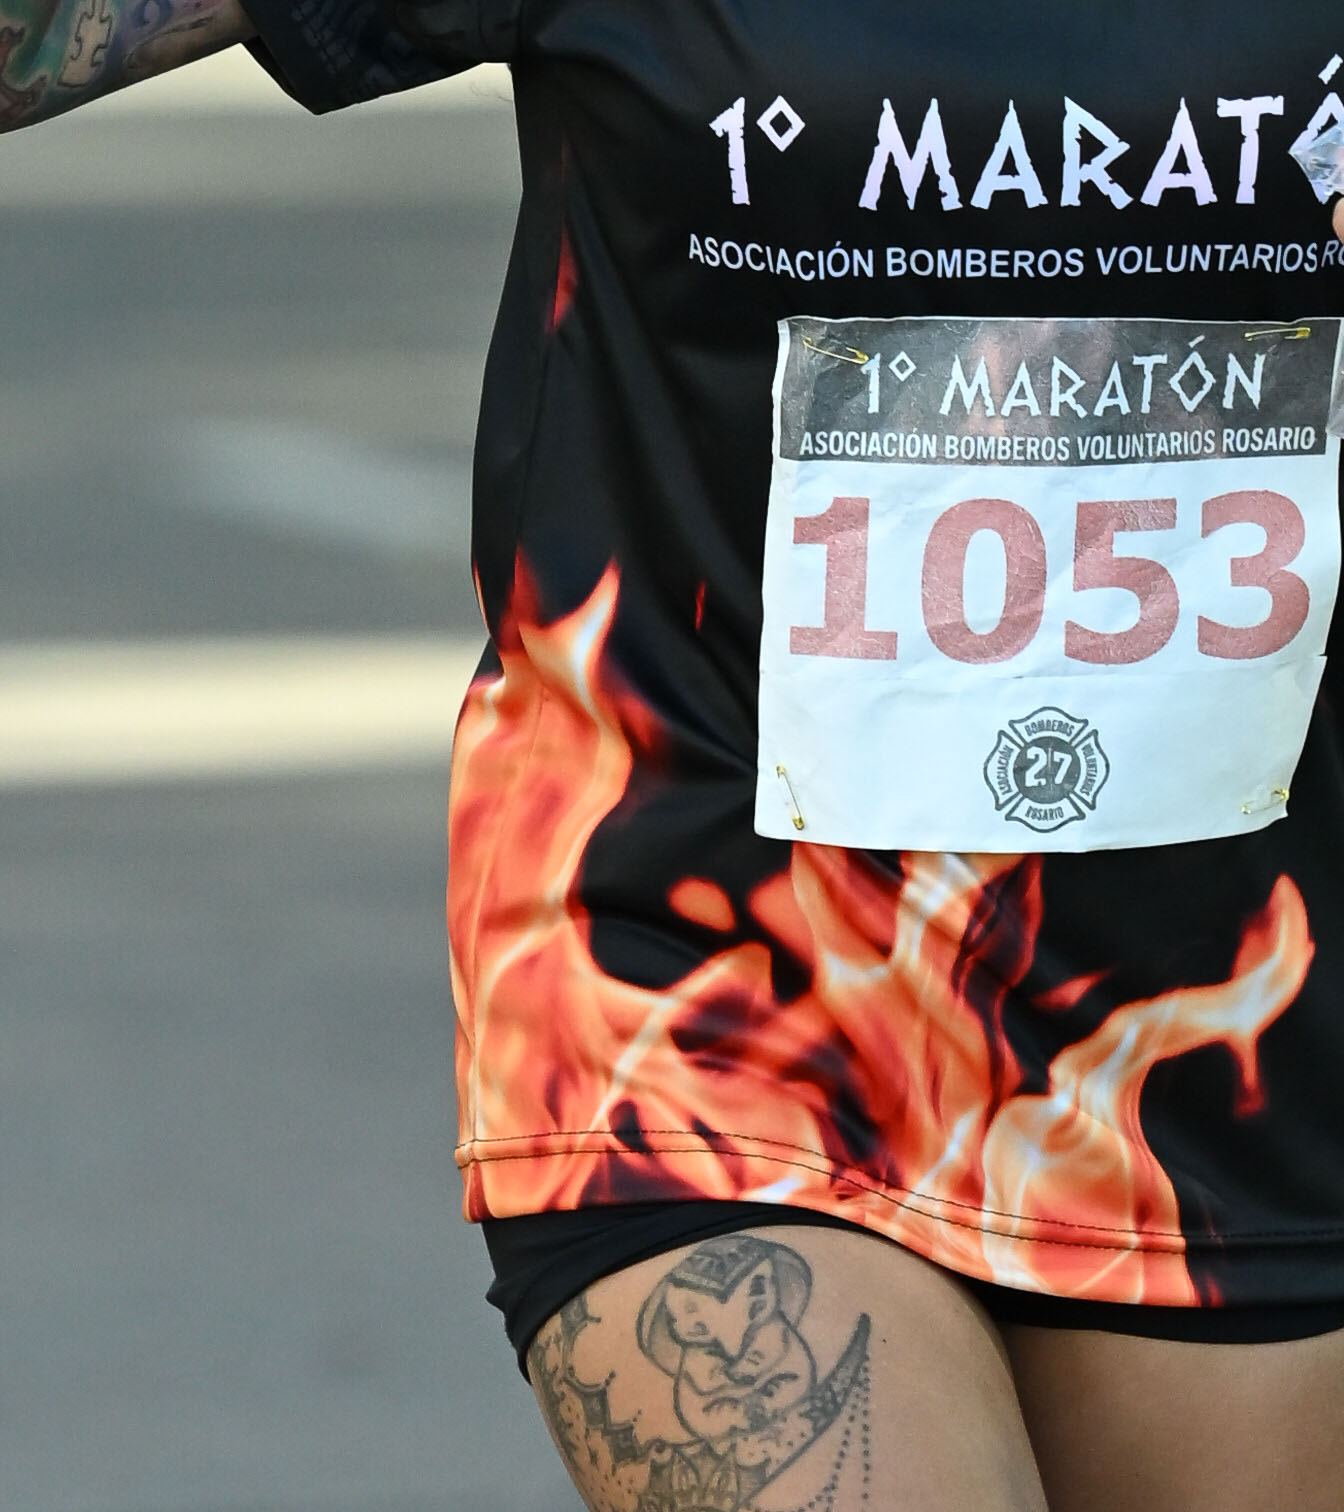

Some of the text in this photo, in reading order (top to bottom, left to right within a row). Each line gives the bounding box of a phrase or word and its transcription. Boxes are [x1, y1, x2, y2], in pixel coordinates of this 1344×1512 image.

[688, 233, 874, 281] ASOCIACIÓN
[886, 246, 1085, 278] BOMBEROS
[1096, 242, 1317, 274] VOLUNTARIOS
[938, 334, 1267, 419] MARATÓN
[799, 425, 1315, 461] ASOCIACIÓN BOMBEROS VOLUNTARIOS ROSARIO
[788, 489, 1311, 666] 1053
[1024, 745, 1073, 787] 27
